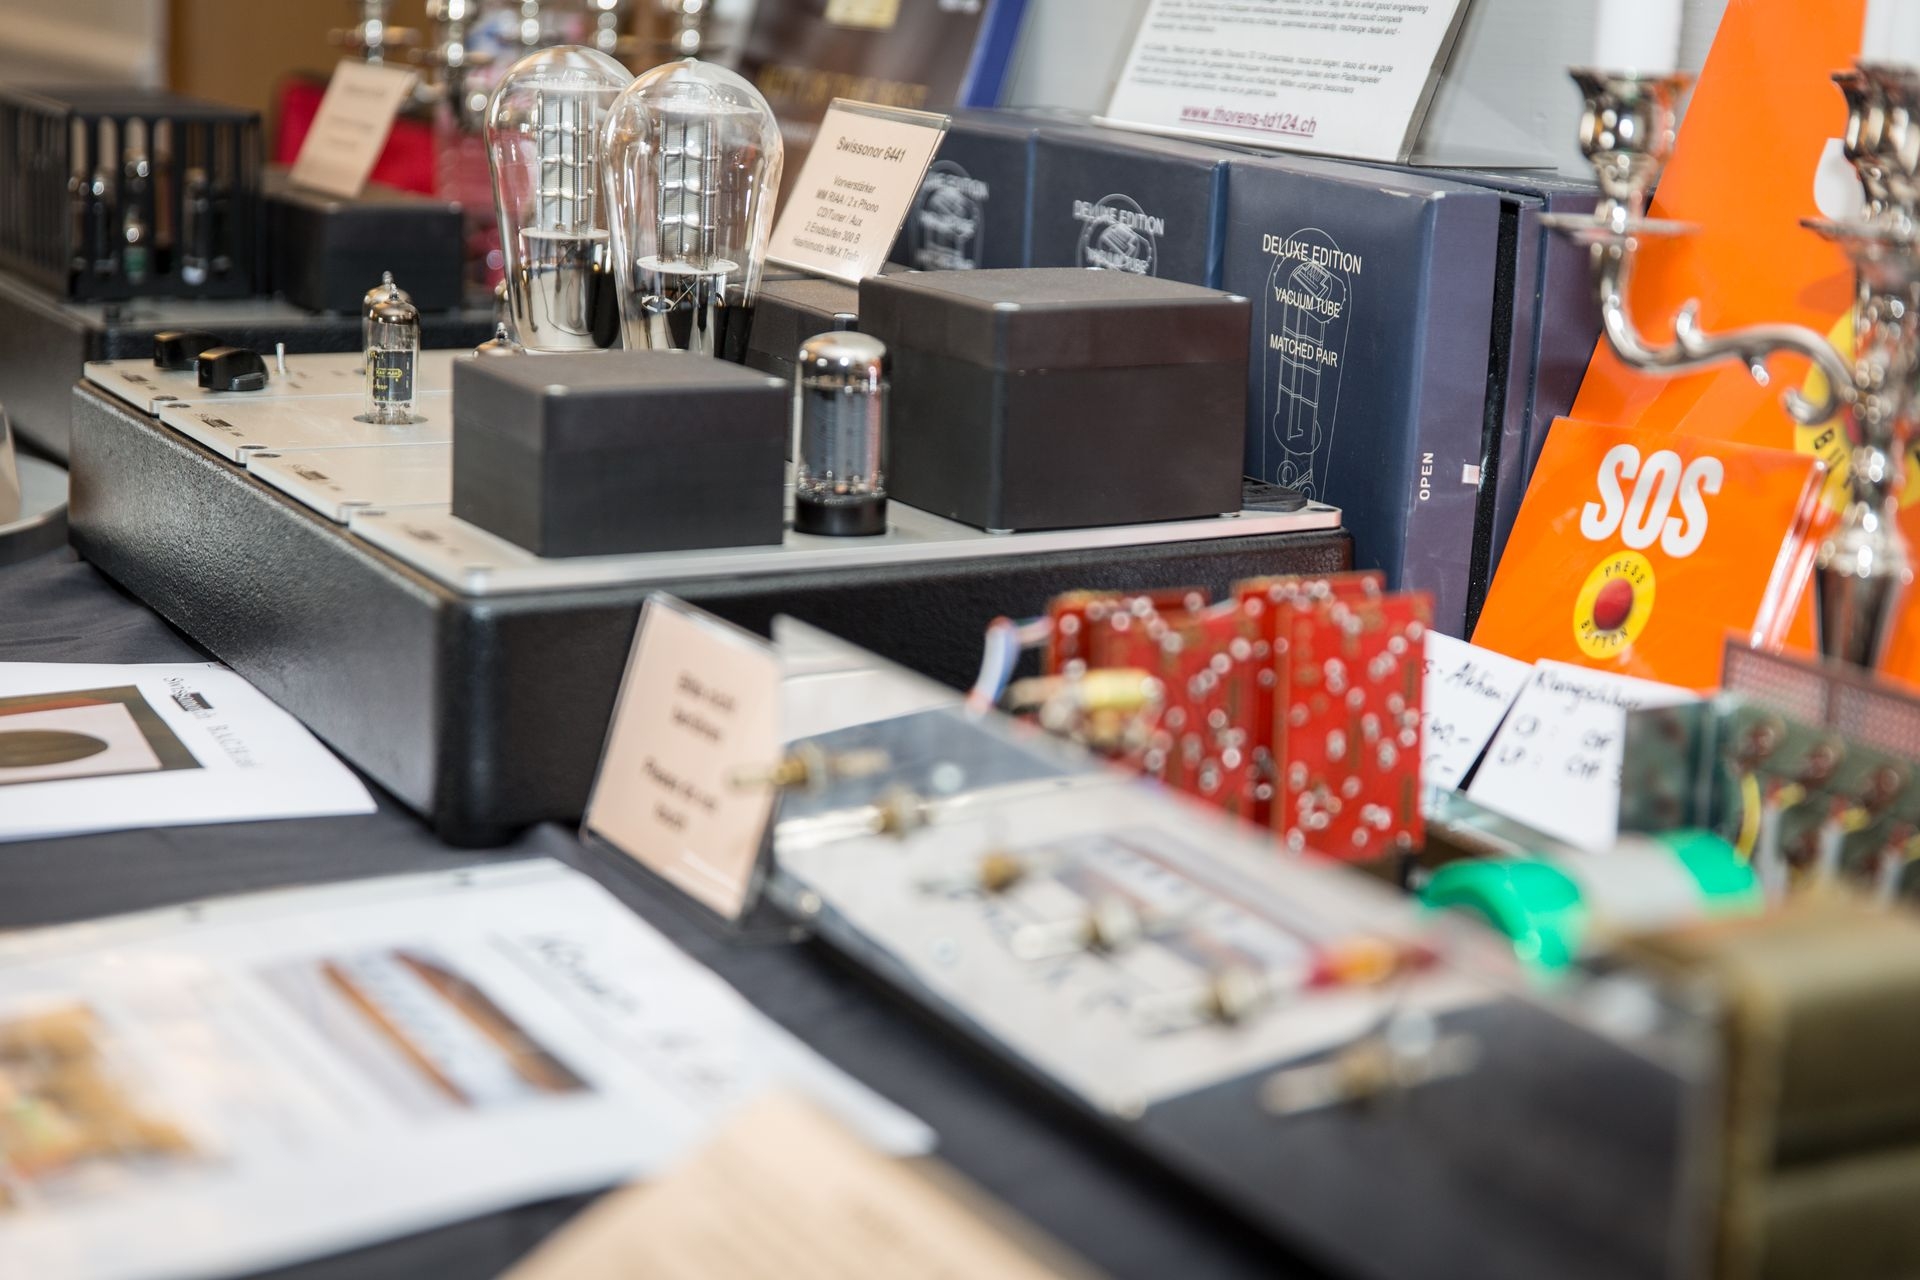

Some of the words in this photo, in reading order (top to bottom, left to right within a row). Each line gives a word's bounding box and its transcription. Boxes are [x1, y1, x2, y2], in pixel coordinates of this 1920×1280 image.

[1180, 104, 1317, 136] www.thorens-td124.ch
[836, 136, 884, 157] Swissonor
[883, 148, 906, 163] 6441
[858, 198, 880, 213] Phono
[1118, 209, 1165, 236] EDITION
[1262, 233, 1309, 262] DELUXE
[1312, 245, 1362, 275] EDITION
[1275, 286, 1314, 311] VACUUM
[1315, 297, 1341, 318] TUBE
[1270, 333, 1315, 360] MATCHED
[1315, 347, 1338, 368] PAIR
[1419, 452, 1434, 501] OPEN
[1580, 443, 1725, 559] SOS
[1604, 560, 1645, 584] PRESS
[1580, 619, 1629, 649] BUTTON
